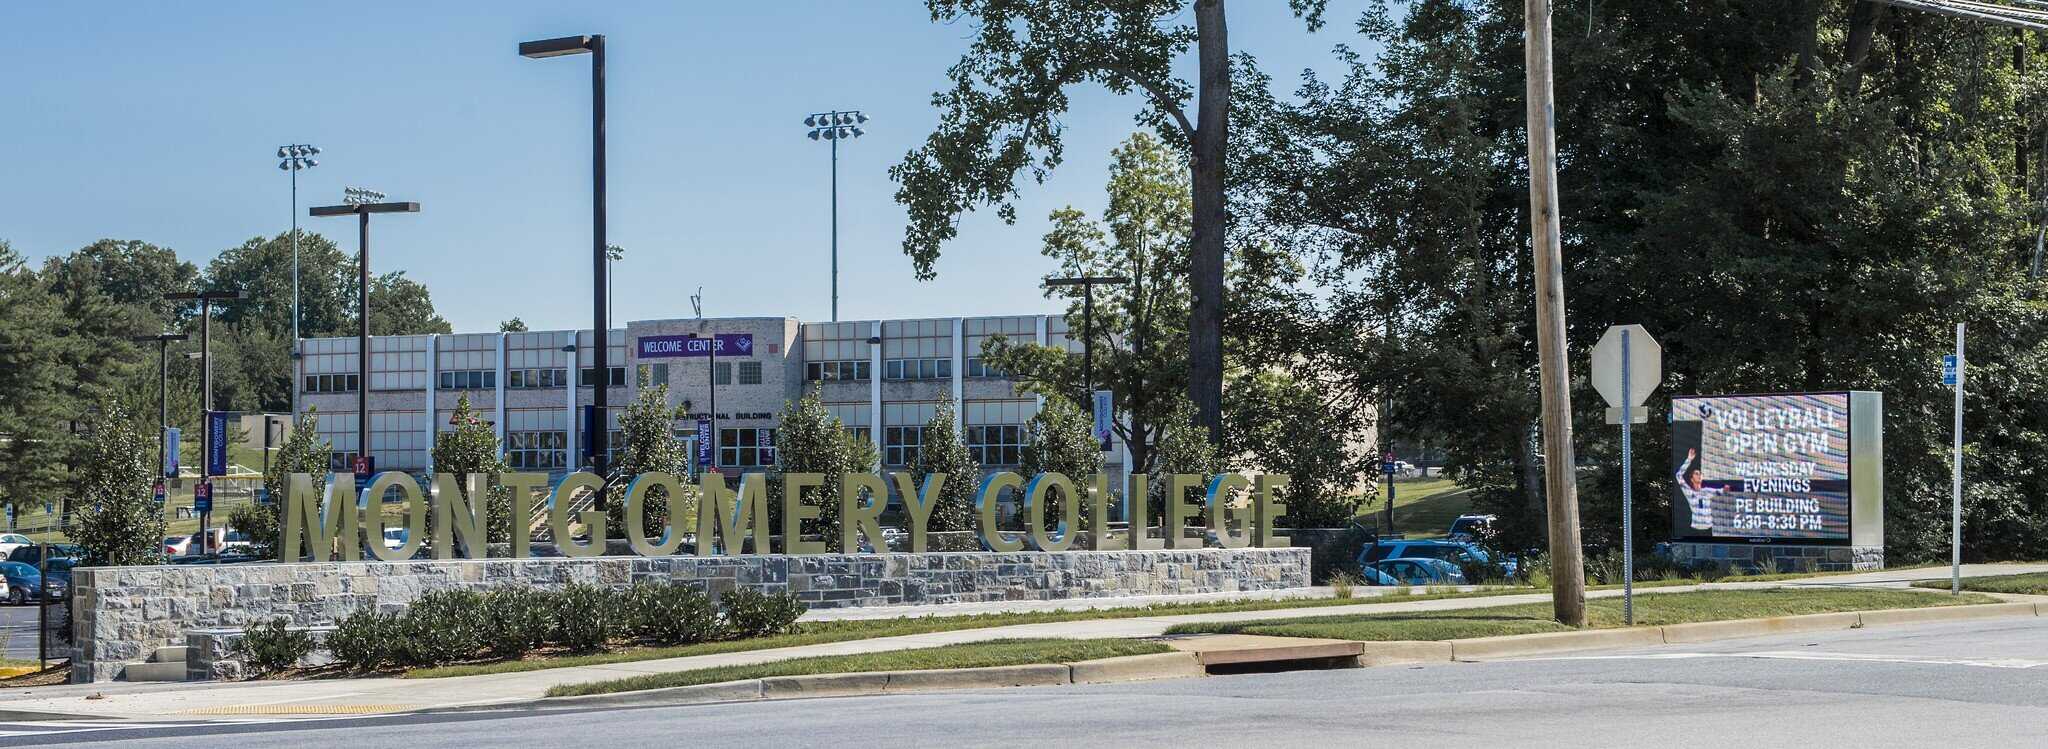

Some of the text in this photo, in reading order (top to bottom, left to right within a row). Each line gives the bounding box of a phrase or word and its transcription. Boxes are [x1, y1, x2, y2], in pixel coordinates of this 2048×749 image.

[643, 340, 724, 352] WELCOME CENTER
[735, 412, 772, 420] BUILDING
[1715, 406, 1835, 430] VOLLEYBALL
[1725, 431, 1829, 455] OPEN GYM
[356, 463, 366, 473] 12
[1735, 461, 1816, 477] WEDNESDAY
[197, 488, 206, 497] 12
[1743, 478, 1811, 493] EVENINGS
[1736, 498, 1820, 513] PE BUILDING
[279, 471, 1291, 563] MONTGOMERY COLLEGE
[1733, 514, 1822, 530] 6:30-8:30 PM
